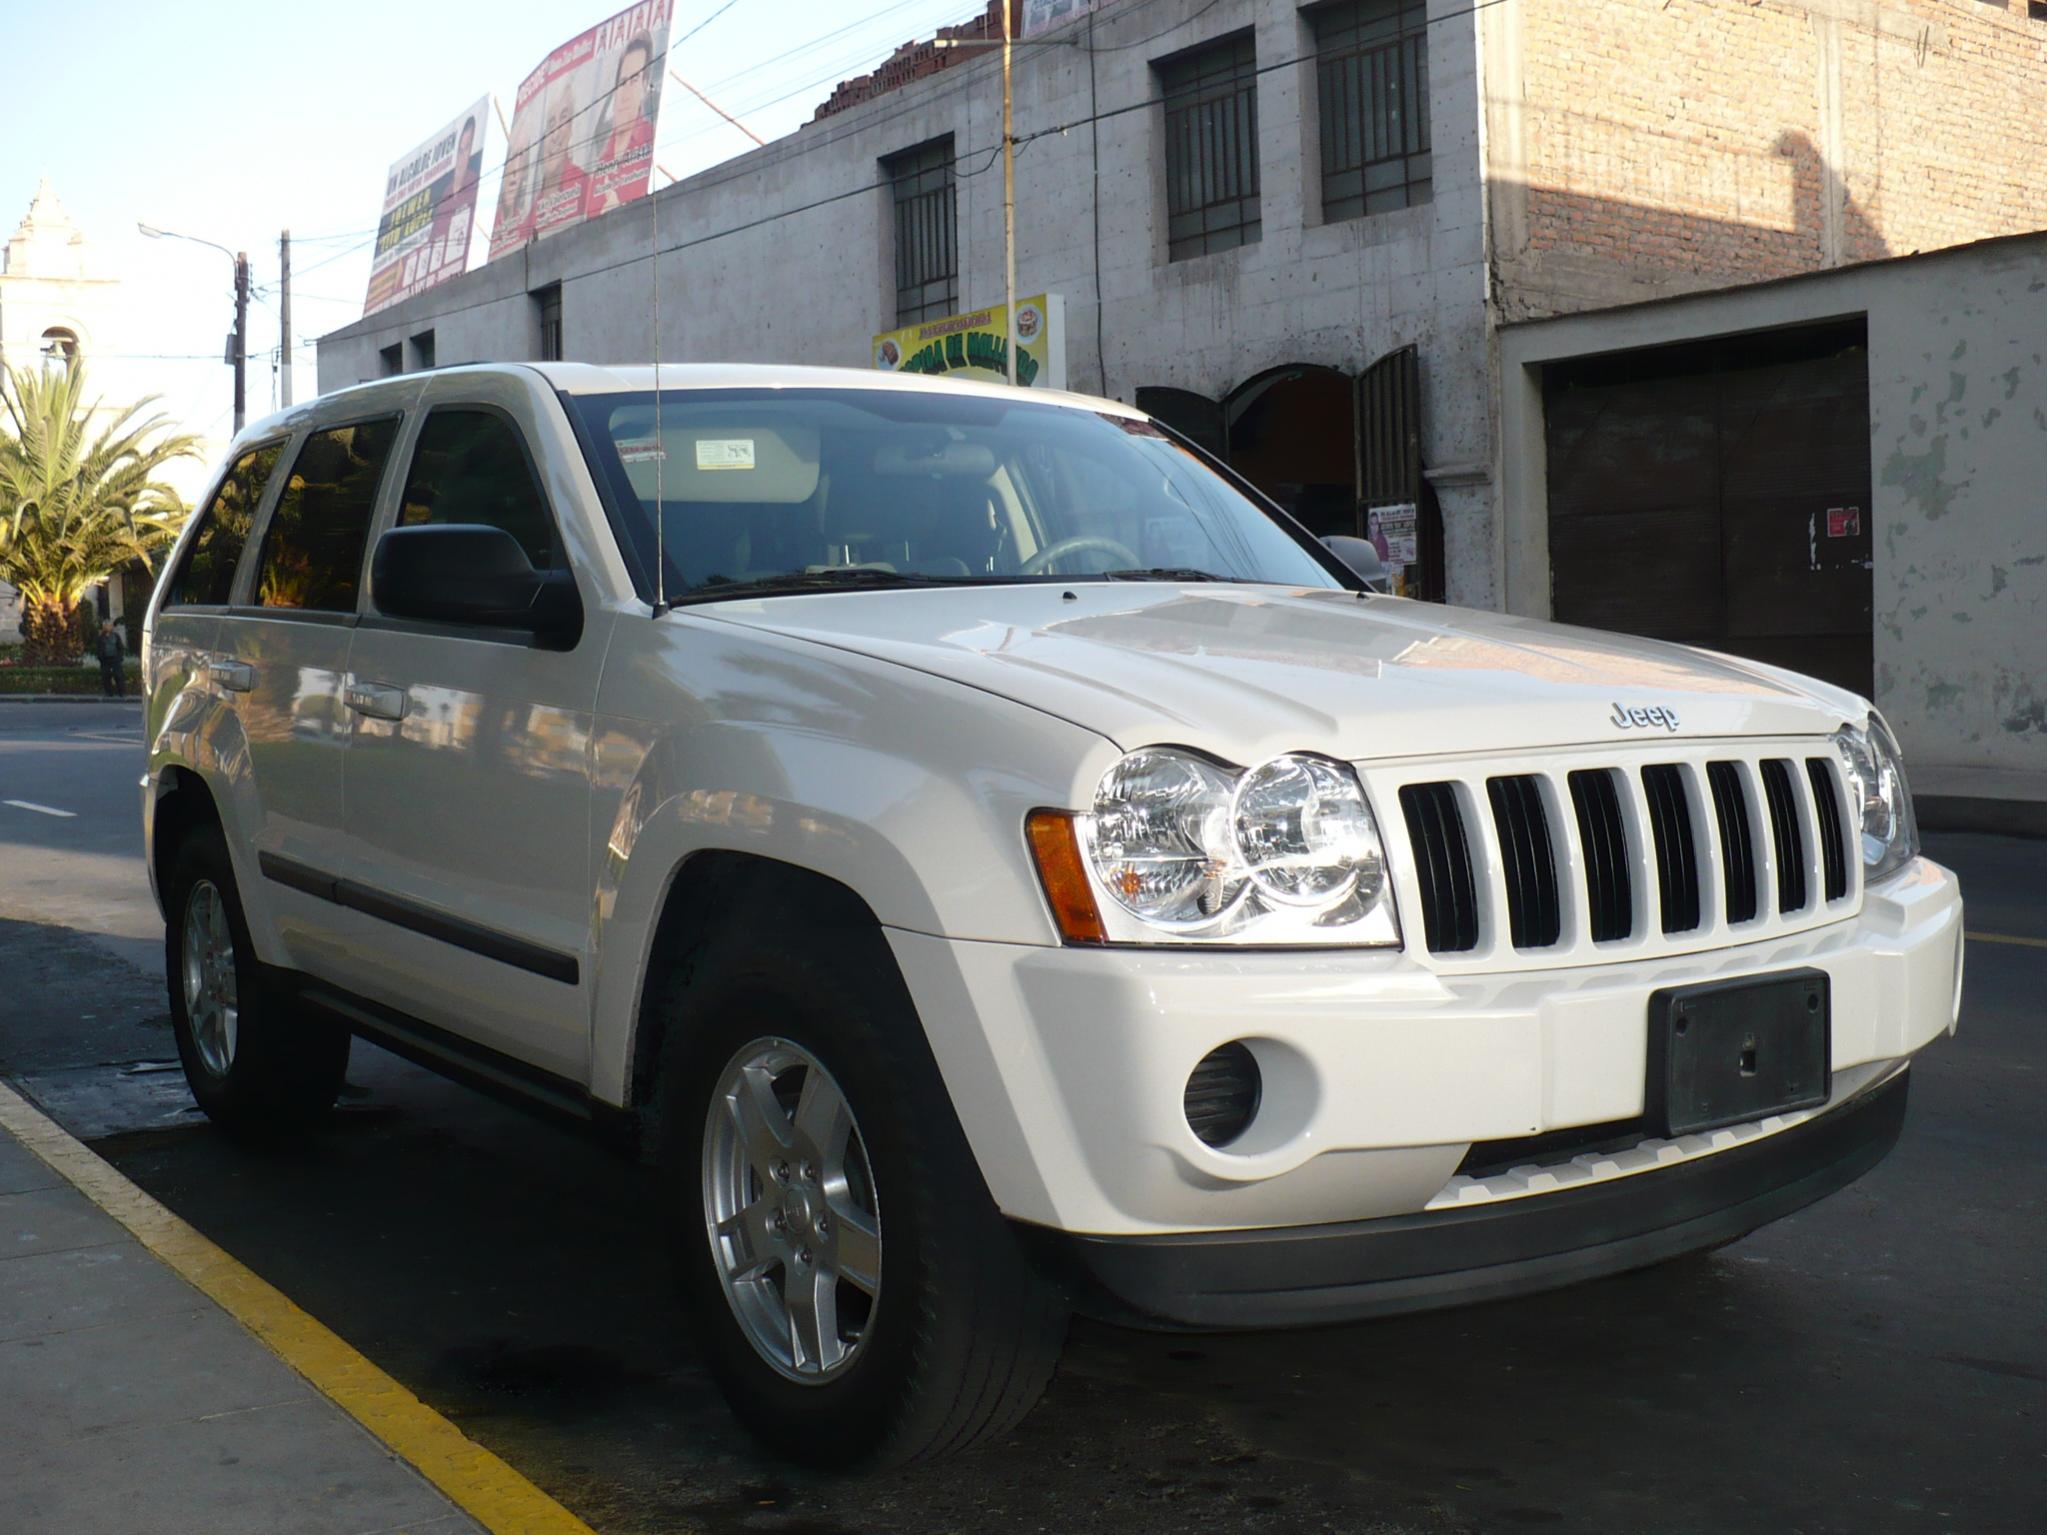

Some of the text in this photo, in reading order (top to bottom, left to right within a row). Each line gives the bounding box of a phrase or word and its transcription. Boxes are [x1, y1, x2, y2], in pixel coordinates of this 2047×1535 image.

[399, 149, 432, 188] ALCALDE
[432, 129, 458, 166] JOVEN
[946, 333, 967, 368] DE
[967, 332, 1039, 386] MOLLNDO
[1609, 702, 1680, 732] Jeep
